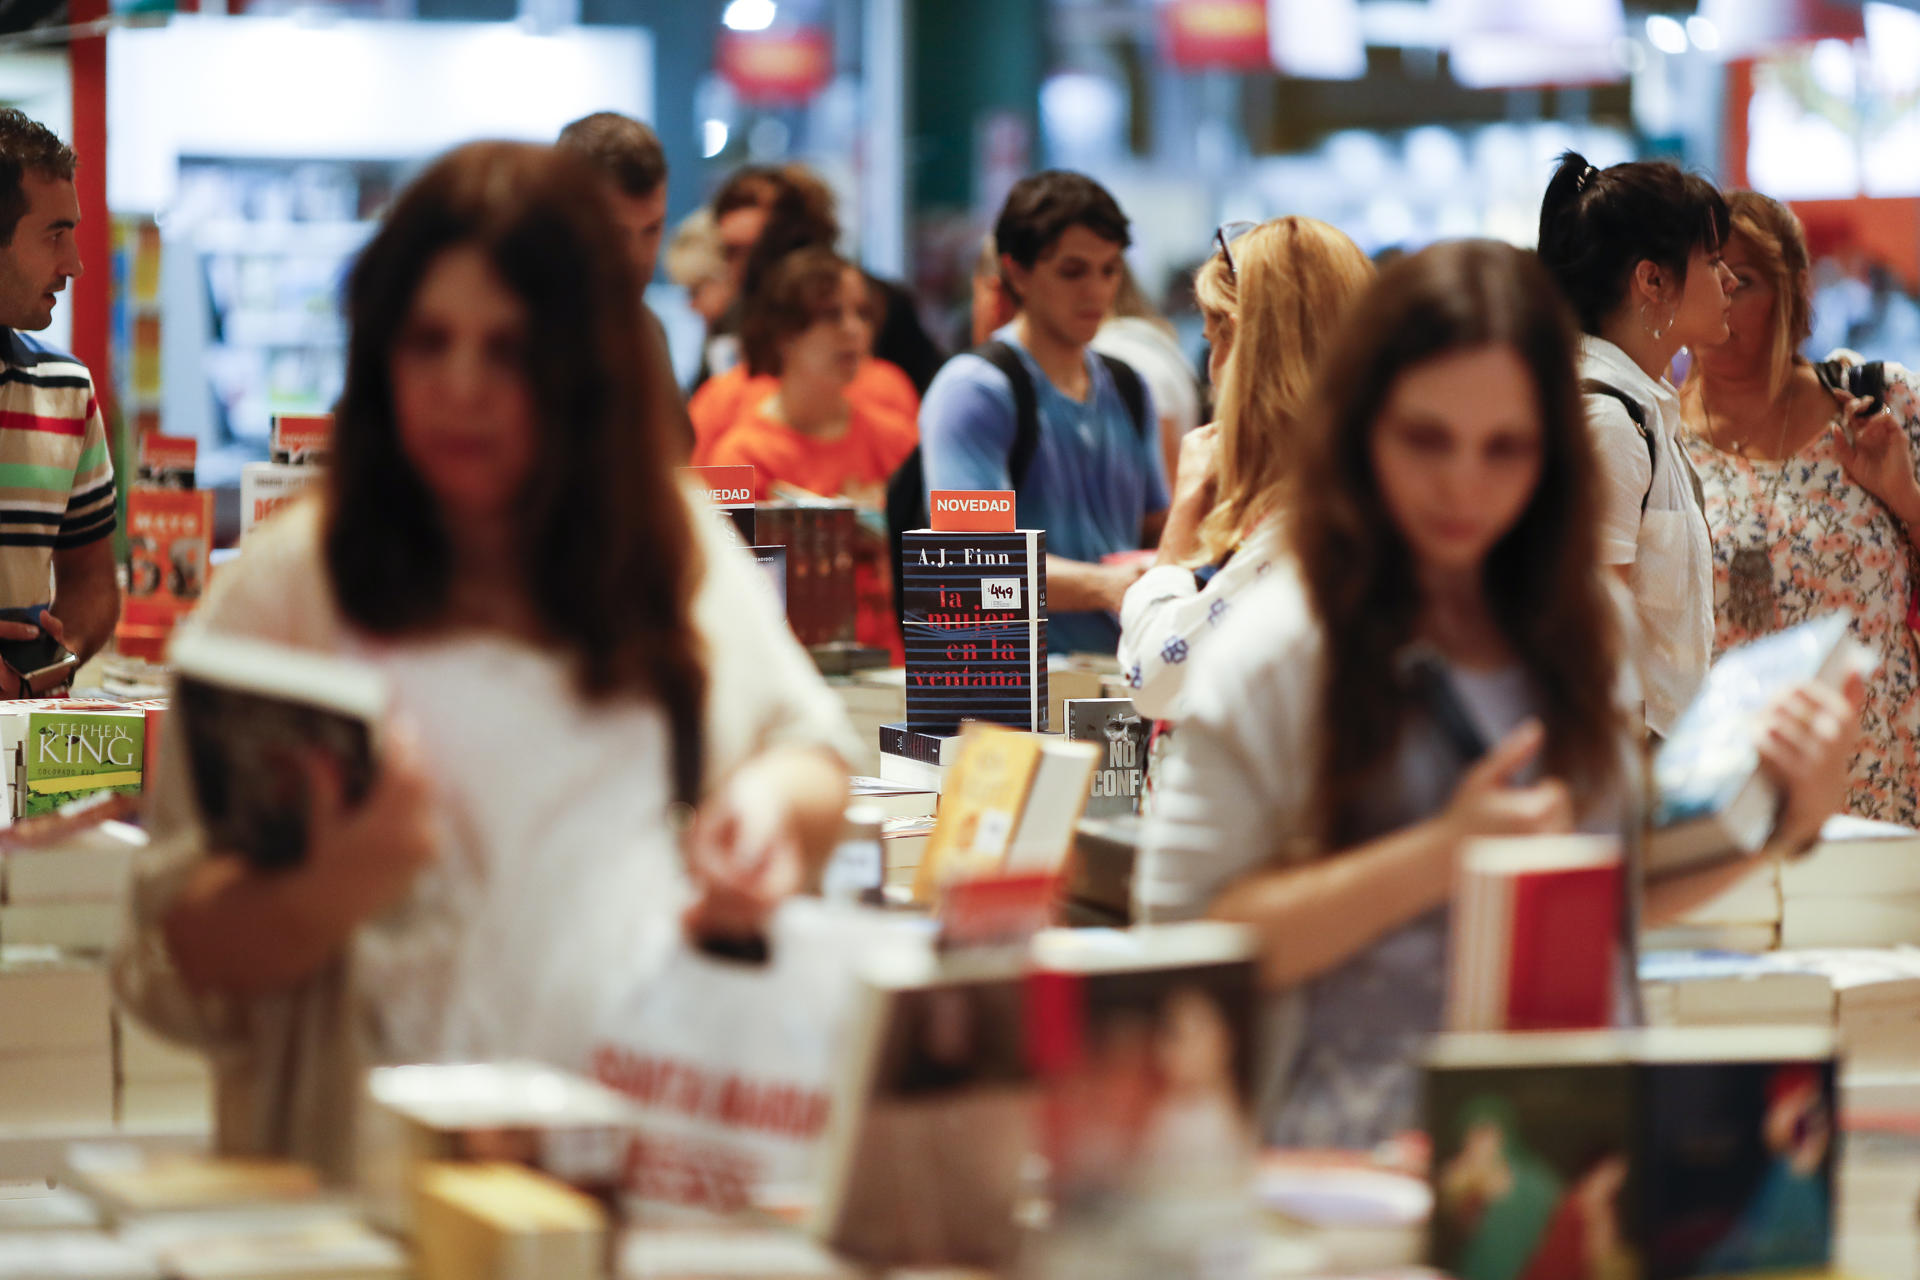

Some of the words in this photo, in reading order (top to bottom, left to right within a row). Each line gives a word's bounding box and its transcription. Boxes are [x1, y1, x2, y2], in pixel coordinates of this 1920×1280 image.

[937, 499, 1010, 512] NOVEDAD
[918, 548, 954, 568] A.J.
[964, 548, 1010, 565] Finn
[939, 584, 962, 608] la
[927, 604, 1016, 638] mujer
[946, 642, 977, 660] en
[991, 636, 1016, 660] la
[913, 666, 1022, 687] ventana
[46, 723, 127, 738] STEPHEN
[38, 734, 133, 766] KING
[1109, 740, 1137, 768] NO
